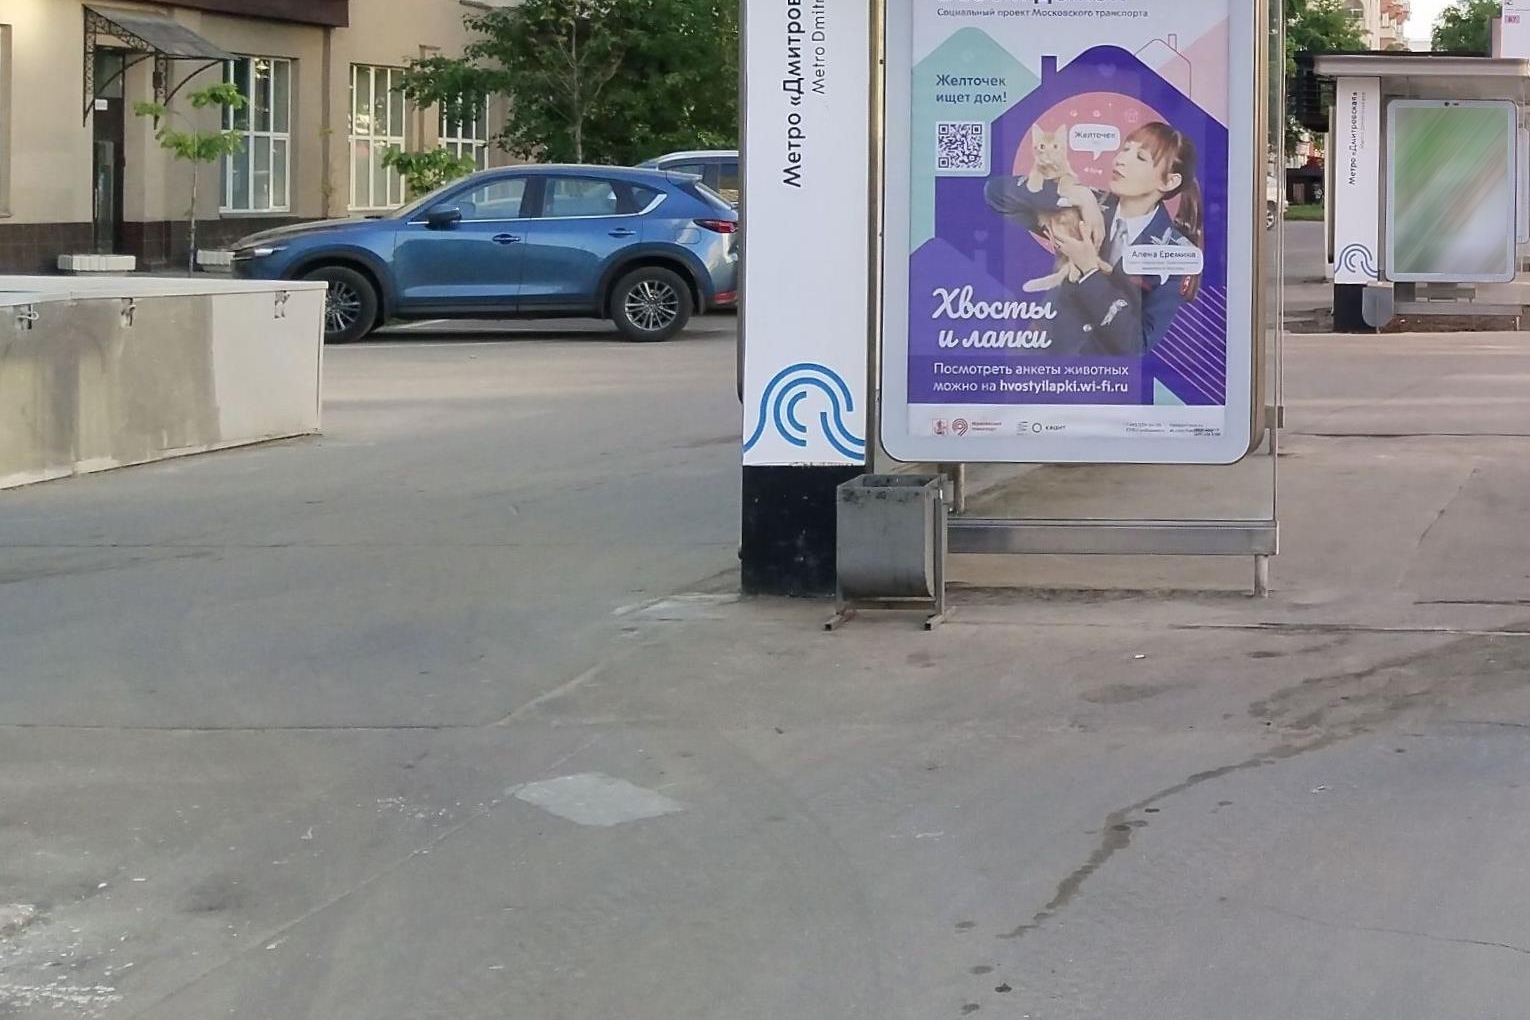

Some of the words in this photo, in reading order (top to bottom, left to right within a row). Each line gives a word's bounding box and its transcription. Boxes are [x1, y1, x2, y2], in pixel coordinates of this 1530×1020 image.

[937, 7, 994, 17] Социальный
[998, 9, 1030, 18] проект
[1032, 9, 1093, 18] Московского
[1095, 10, 1148, 18] транспорта
[811, 46, 825, 95] Metro
[936, 74, 1006, 87] Желточек
[936, 93, 970, 103] ищет
[974, 92, 1007, 104] дом!
[783, 112, 805, 188] Метро
[931, 284, 1058, 320] Хвосты
[938, 330, 959, 348] и
[962, 330, 1052, 349] лапки
[933, 363, 1012, 376] Посмотреть
[1015, 364, 1061, 375] анкеты
[1063, 365, 1129, 376] животных
[932, 381, 978, 392] можно
[982, 383, 997, 392] на
[1000, 380, 1129, 393] hvostyilapki.wi-fi.ru
